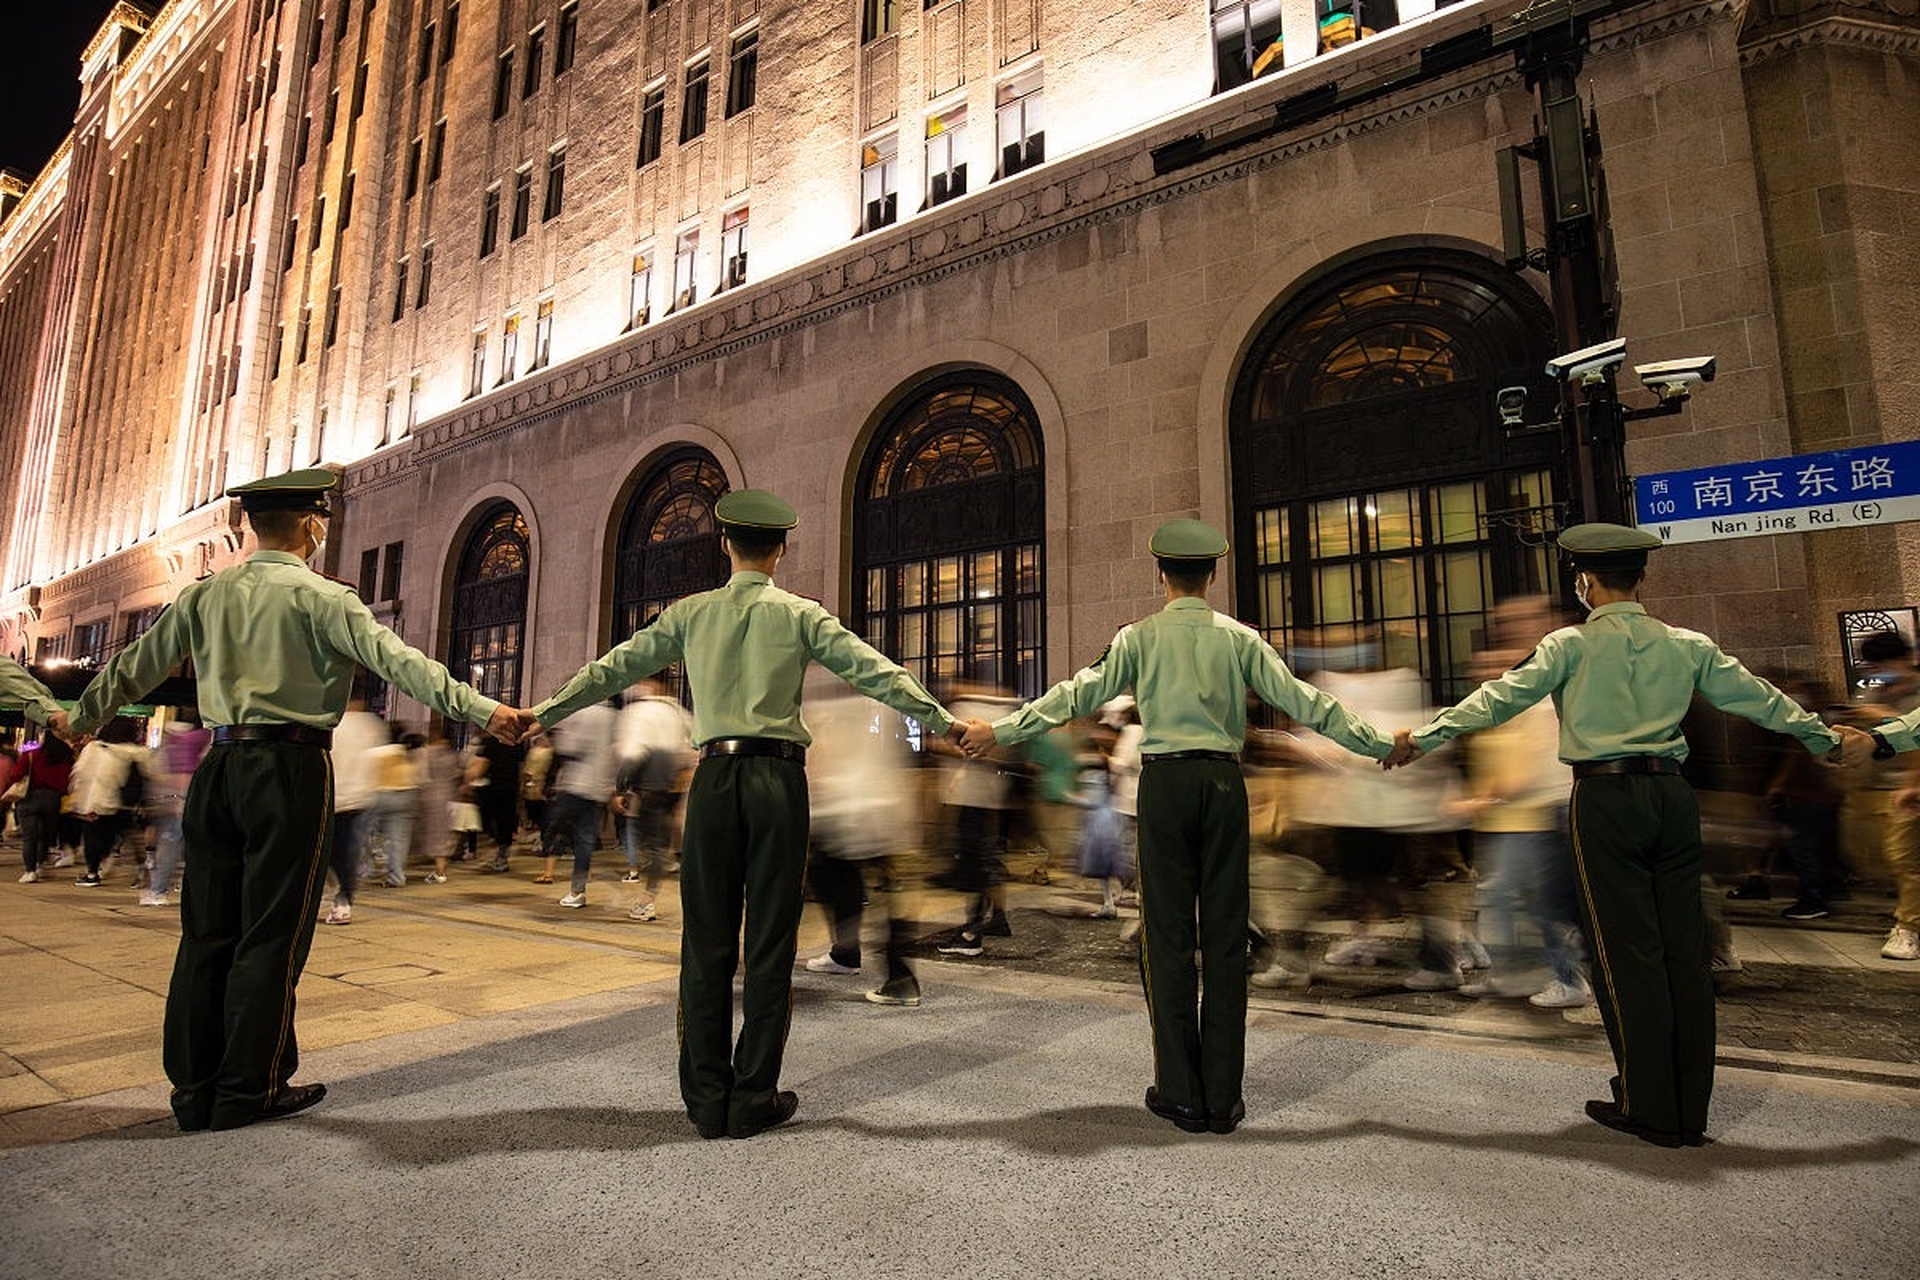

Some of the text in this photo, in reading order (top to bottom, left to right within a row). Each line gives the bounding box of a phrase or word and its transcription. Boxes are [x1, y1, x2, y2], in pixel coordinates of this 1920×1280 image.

[1651, 480, 1669, 496] 西
[1693, 457, 1895, 509] 南京东路
[1650, 500, 1675, 516] 100
[1809, 509, 1840, 524] Rd.
[1853, 502, 1882, 520] (E)
[1659, 526, 1671, 540] W
